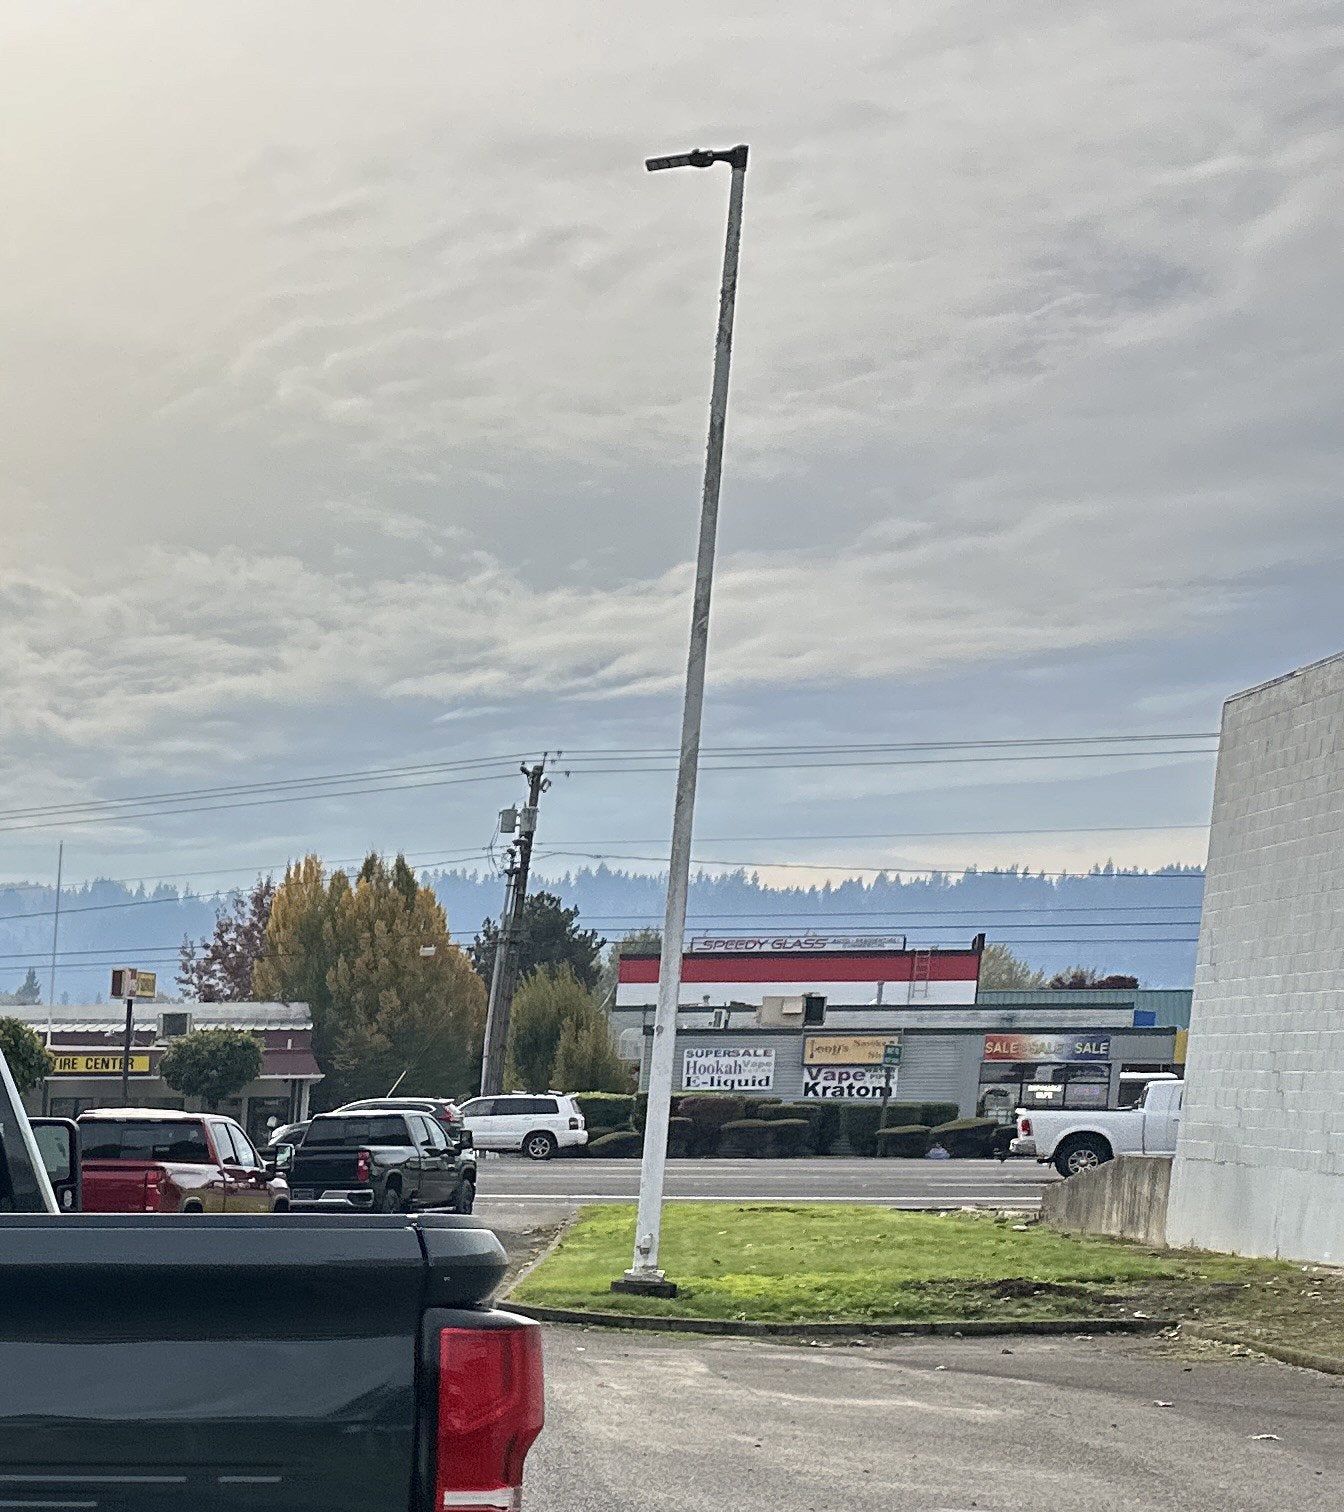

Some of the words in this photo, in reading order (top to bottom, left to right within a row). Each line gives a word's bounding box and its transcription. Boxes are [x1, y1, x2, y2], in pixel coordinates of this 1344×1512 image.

[696, 939, 768, 950] SPEEDY
[771, 938, 829, 950] GLASS
[686, 1049, 772, 1058] SUPERSALE
[985, 1042, 1018, 1054] SALE
[1074, 1042, 1109, 1054] SALE
[53, 1057, 78, 1070] TIRE
[685, 1060, 742, 1075] Hookah
[807, 1066, 866, 1084] Vape
[685, 1075, 771, 1090] E-liquid
[803, 1082, 893, 1097] Kratom
